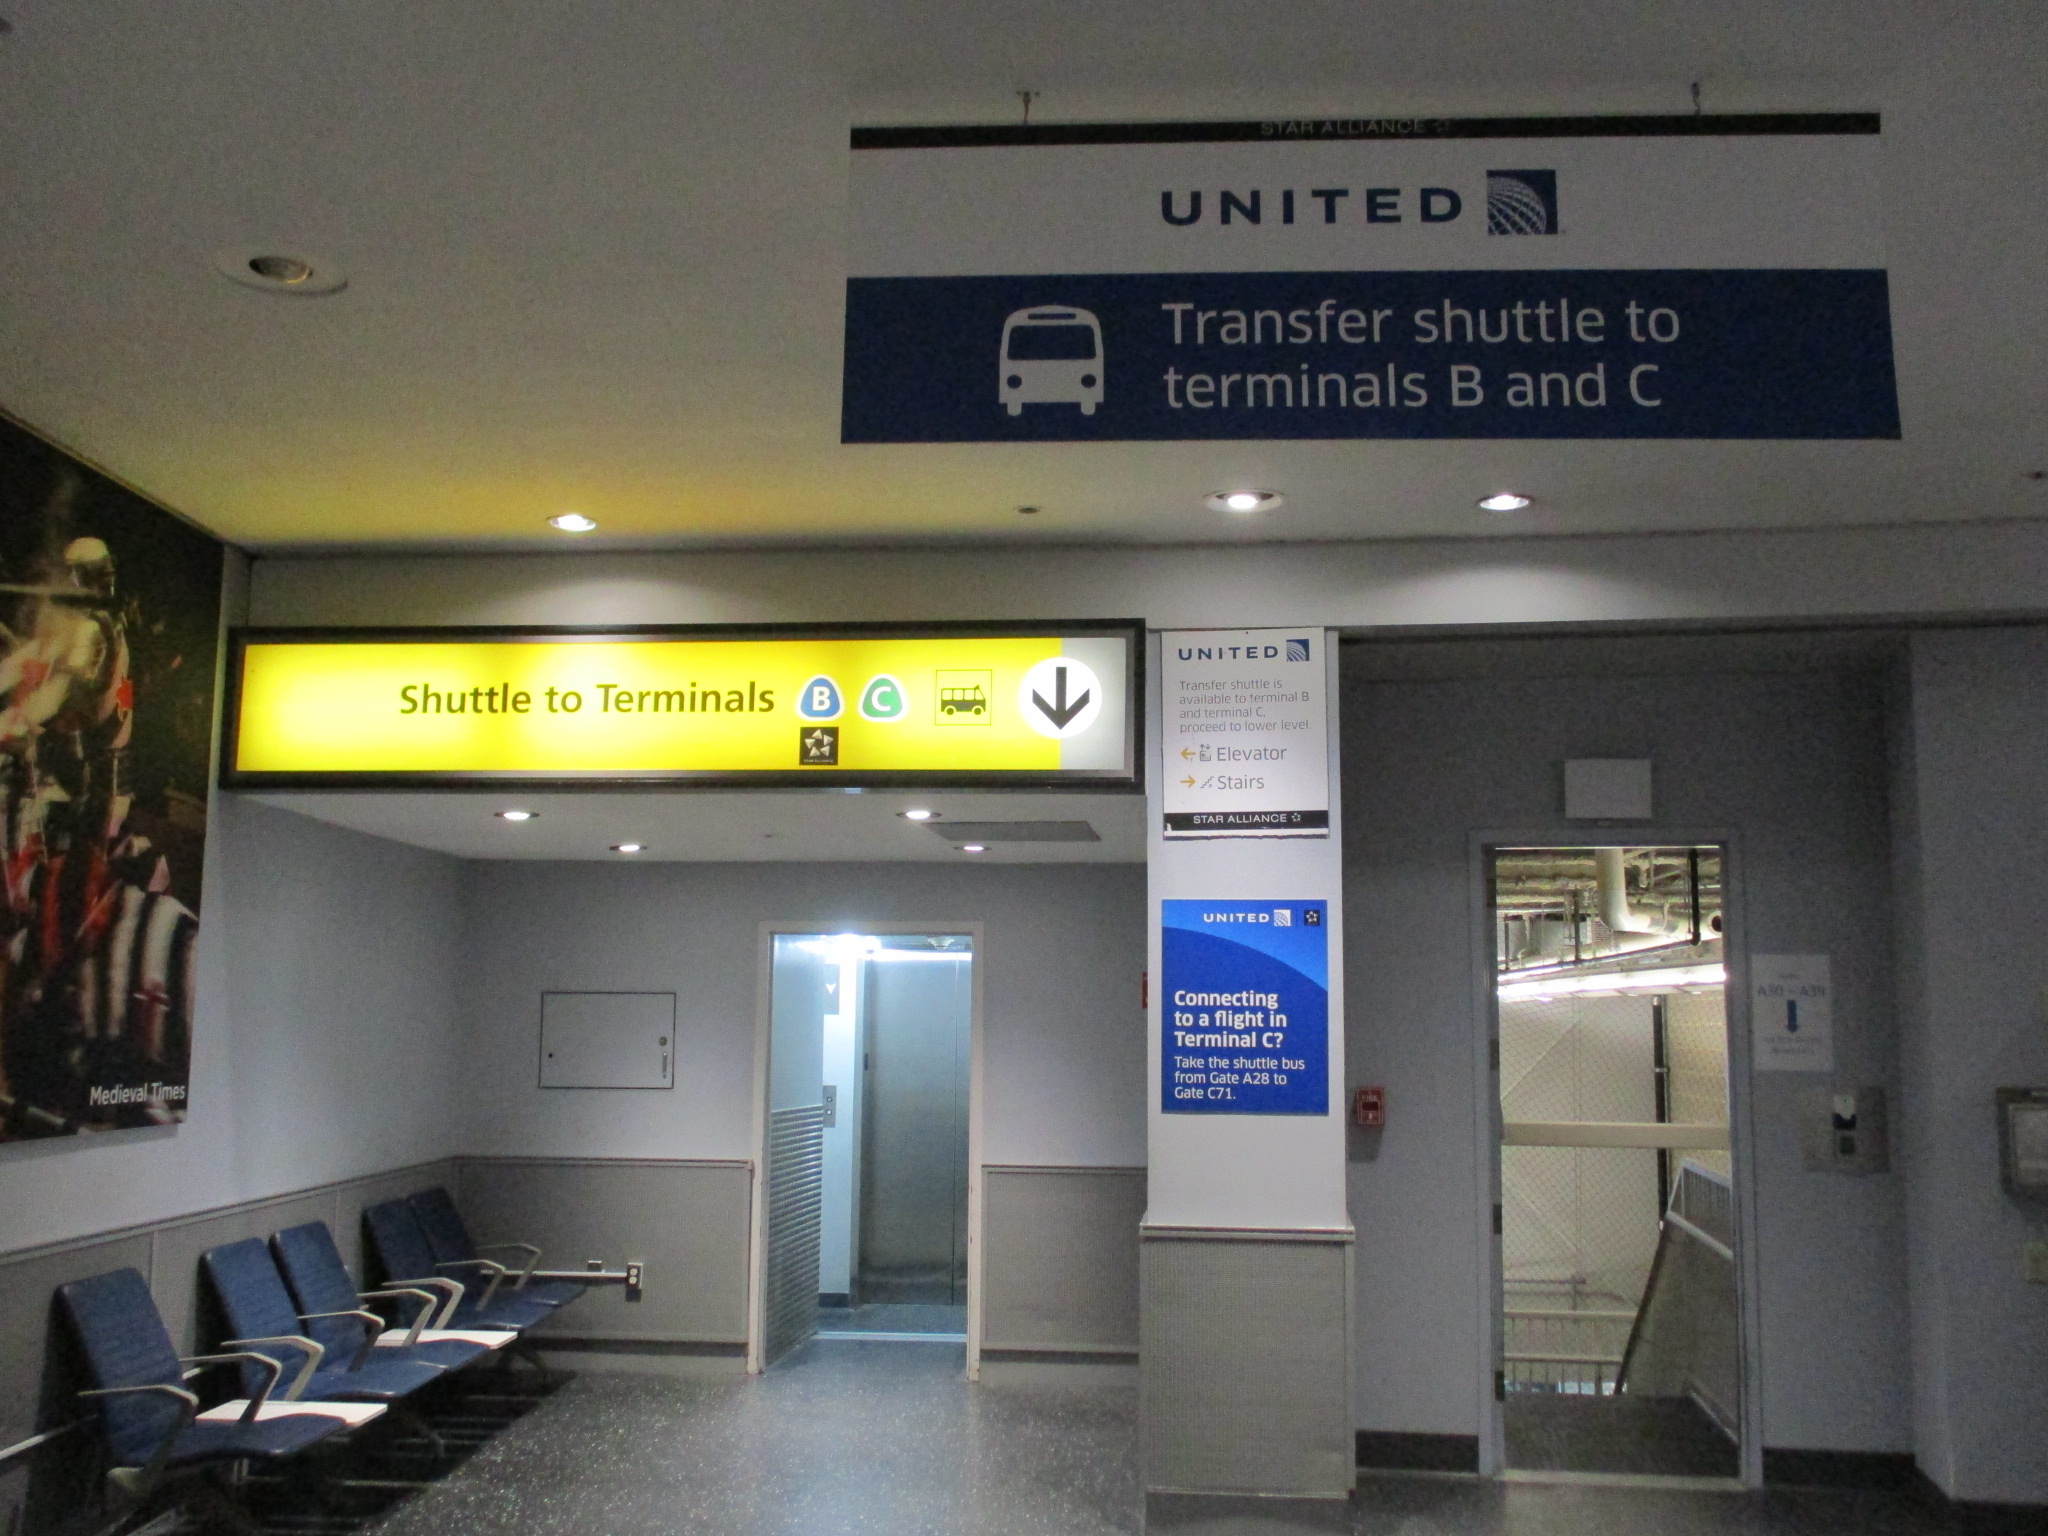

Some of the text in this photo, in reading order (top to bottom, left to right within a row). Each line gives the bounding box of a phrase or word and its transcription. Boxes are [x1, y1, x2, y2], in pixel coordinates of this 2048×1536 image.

[1261, 119, 1426, 135] STAR ALLIANCE
[1161, 186, 1463, 226] UNITED
[1162, 297, 1680, 345] Transfer shuttle to
[1163, 362, 1661, 410] terminals B and C
[1178, 646, 1279, 661] UNITED
[1179, 678, 1282, 691] Transfer shuttle is
[400, 681, 775, 715] Shuttle to Terminals
[812, 687, 830, 711] B
[871, 685, 891, 712] C
[1179, 692, 1310, 705] available to terminal B
[1180, 708, 1201, 718] and
[1204, 707, 1252, 718] terminal
[1180, 719, 1312, 734] proceed to lower level.
[1217, 746, 1287, 761] Elevator
[1217, 775, 1265, 790] Stairs
[1193, 814, 1287, 824] STAR ALLIANCE
[1203, 913, 1270, 923] UNITED
[1174, 990, 1278, 1010] Connecting
[1174, 1011, 1287, 1029] to a flight in
[1174, 1031, 1283, 1048] Terminal C?
[1174, 1056, 1305, 1070] Take the shuttle bus
[1174, 1071, 1287, 1085] from Gate A28 to
[90, 1082, 186, 1105] Medieval Times
[1174, 1087, 1236, 1099] Gate C71.
